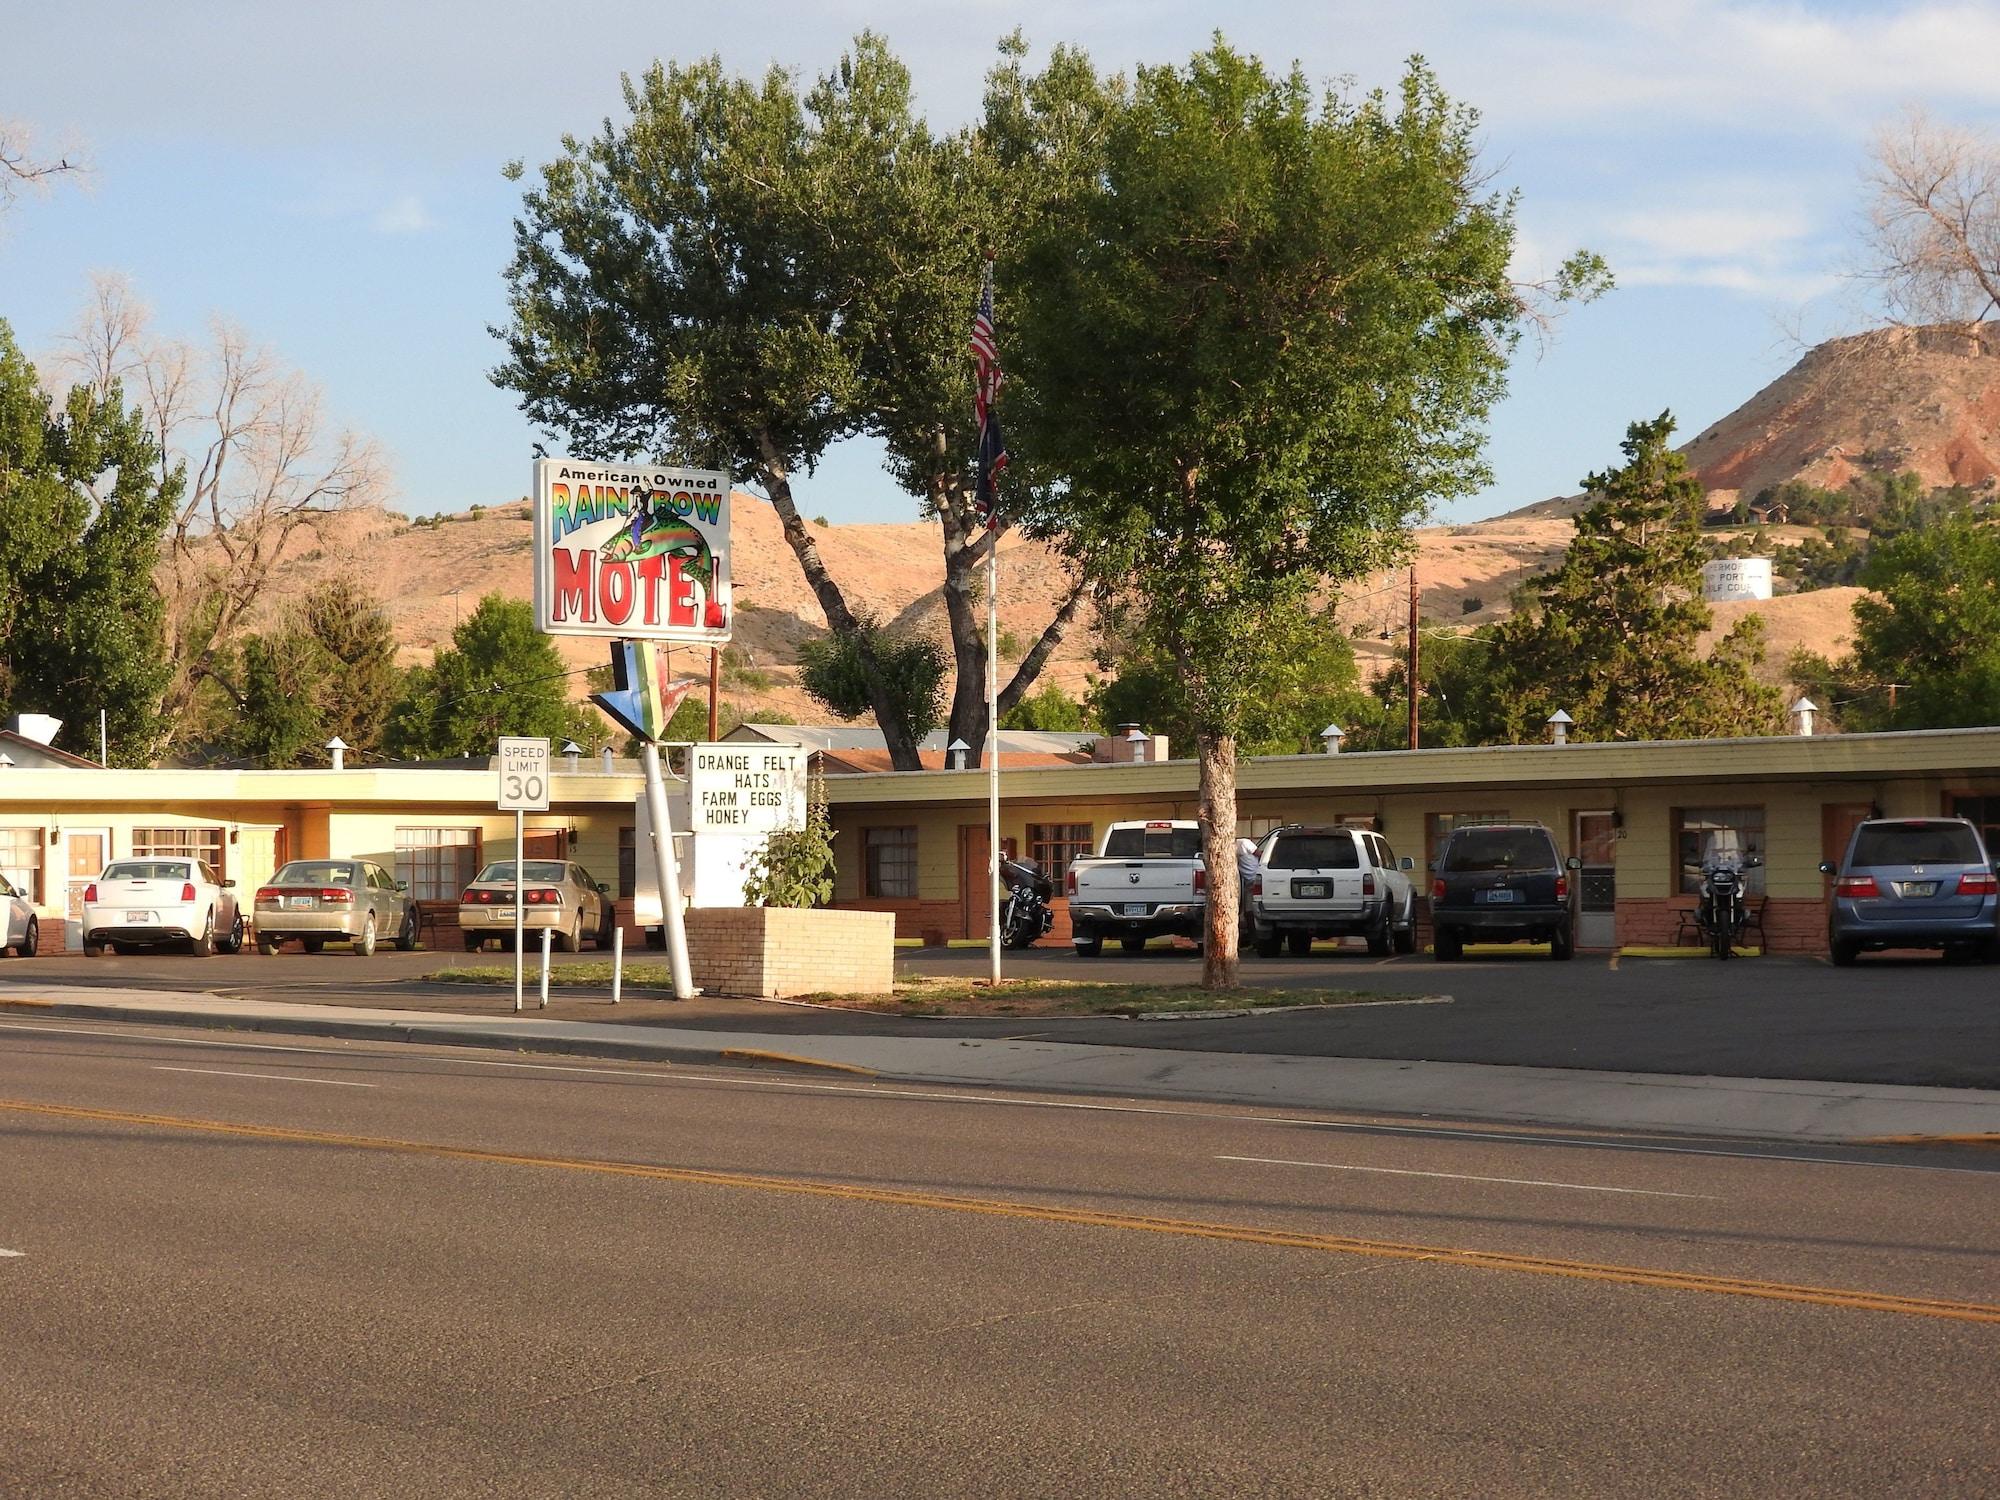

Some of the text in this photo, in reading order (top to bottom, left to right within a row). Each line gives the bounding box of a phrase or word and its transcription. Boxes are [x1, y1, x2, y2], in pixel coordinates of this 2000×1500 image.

[559, 467, 717, 489] American Owned
[552, 482, 722, 545] RAINBOW
[552, 547, 726, 628] MOTEL
[504, 746, 545, 758] SPEED
[508, 760, 540, 772] LIMIT
[698, 755, 796, 771] ORANGE FELT
[505, 775, 543, 801] 30
[735, 773, 770, 788] HATS
[702, 791, 782, 807] FARM EGGS
[706, 809, 749, 824] HONEY
